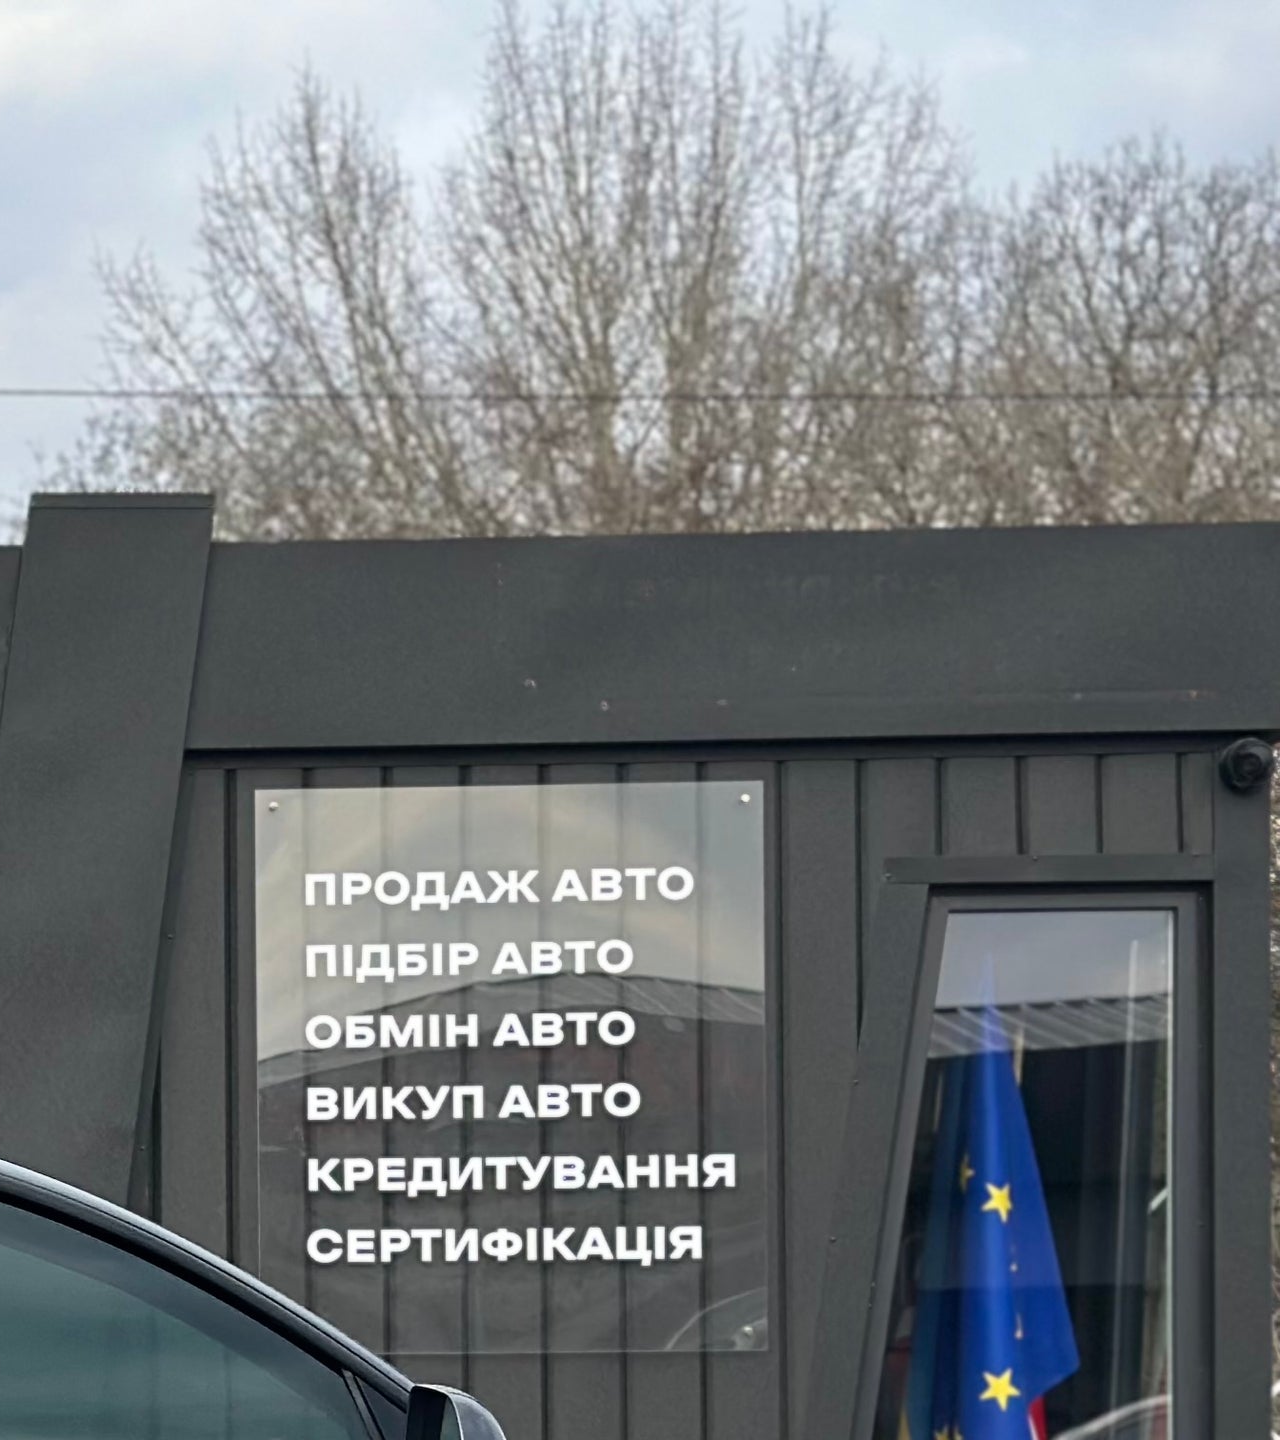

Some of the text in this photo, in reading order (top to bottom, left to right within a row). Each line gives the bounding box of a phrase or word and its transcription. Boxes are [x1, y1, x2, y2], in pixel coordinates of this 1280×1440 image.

[304, 866, 695, 912] ПРОДАЖ АВТО
[305, 939, 634, 984] ПІДБІР АВТО
[305, 1011, 636, 1050] ОБМІН АВТО
[307, 1082, 641, 1121] ВИКУП АВТО
[307, 1153, 736, 1197] КРЕДИТУВАННЯ
[306, 1225, 702, 1267] СЕРТИФІКАЦІЯ
